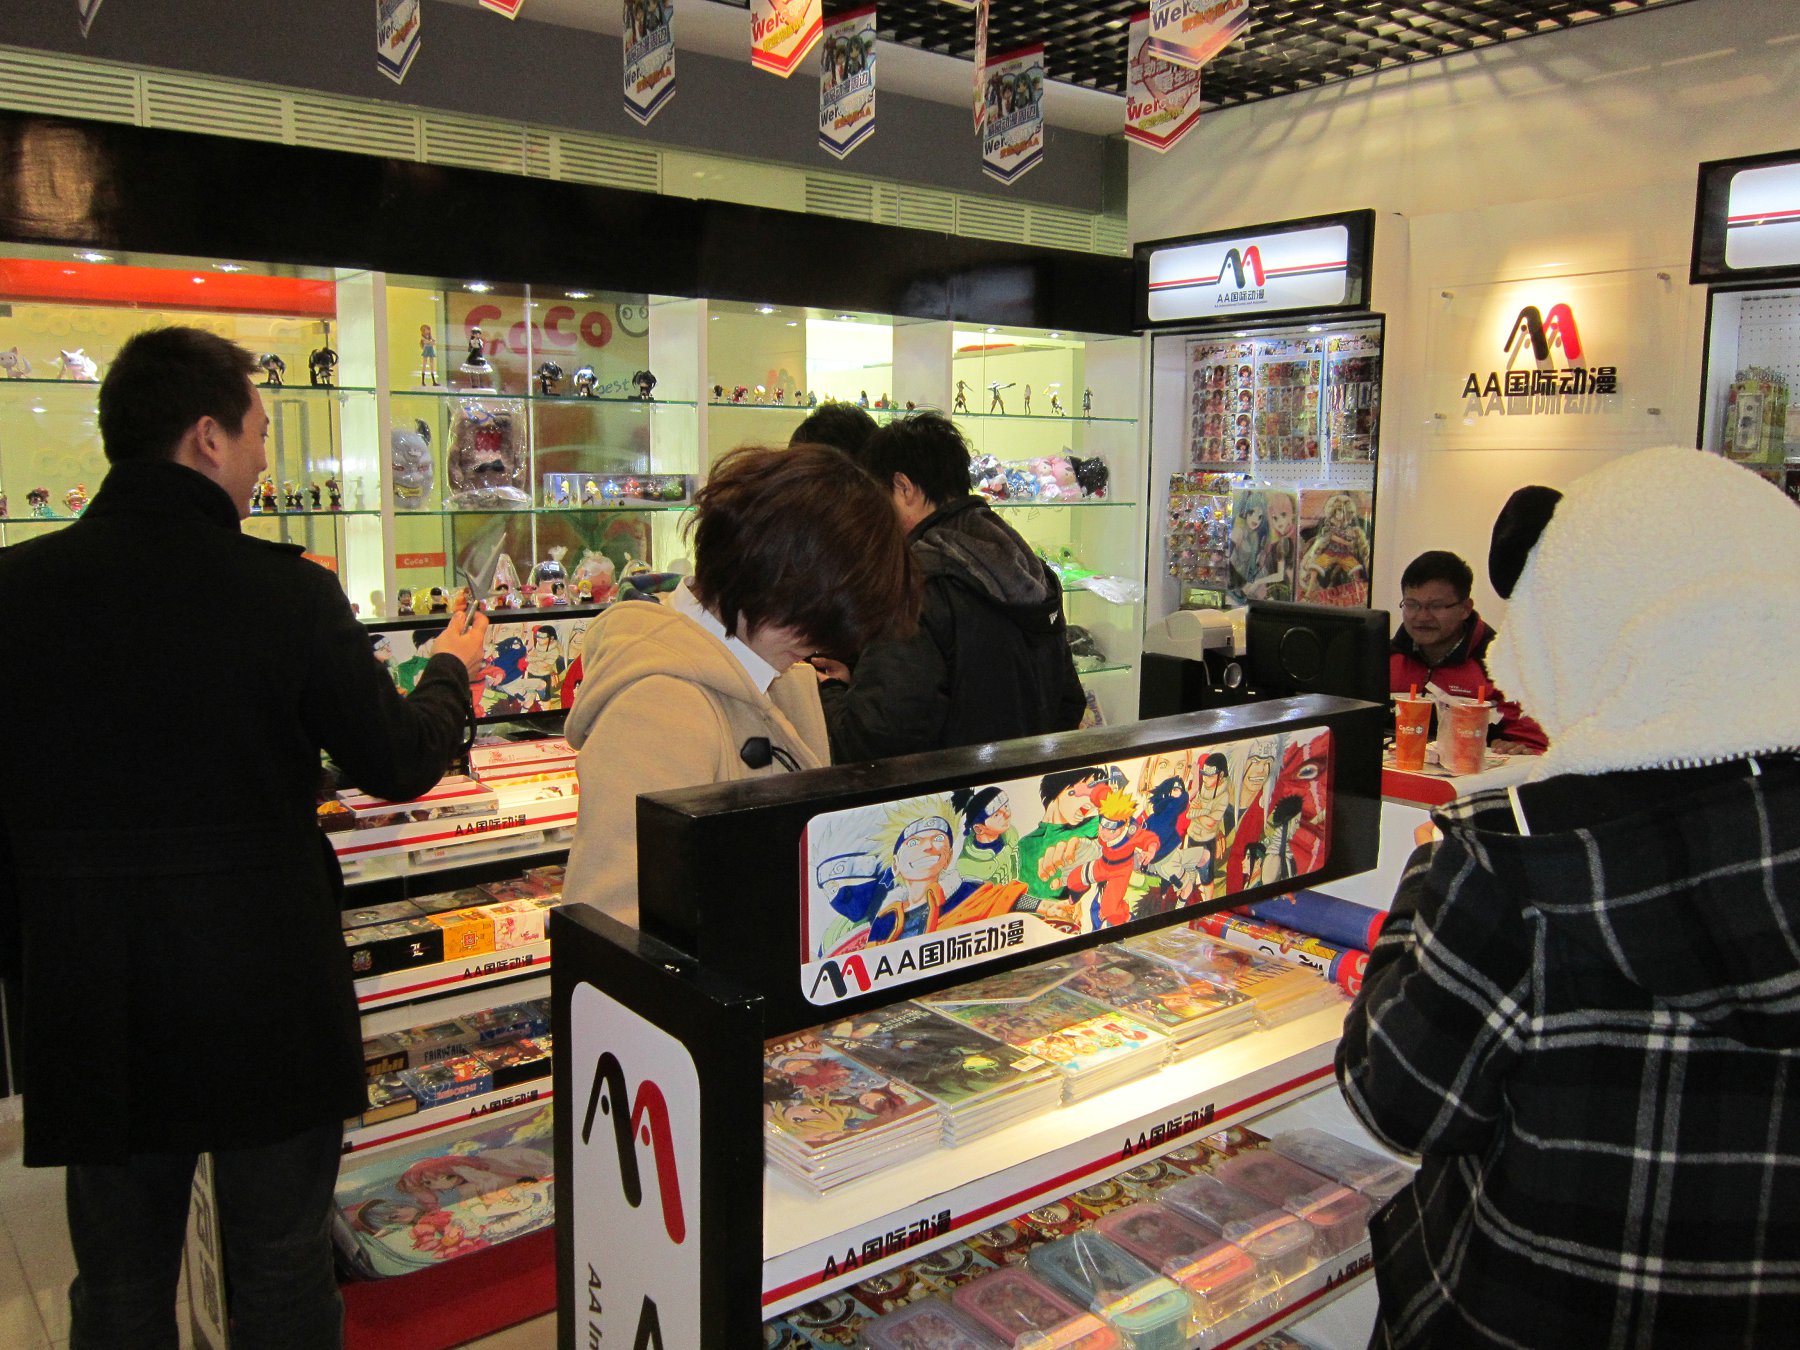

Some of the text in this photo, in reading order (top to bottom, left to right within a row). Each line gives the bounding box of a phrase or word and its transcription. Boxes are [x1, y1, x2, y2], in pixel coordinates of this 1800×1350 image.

[1217, 289, 1265, 303] AA国际动漫
[1462, 367, 1617, 398] AA国际动漫
[455, 814, 526, 837] AA国际动漫
[874, 920, 1024, 980] AA国际动漫
[464, 954, 533, 979] AA国际动漫
[1121, 1103, 1214, 1160] AA国际动漫
[822, 1209, 951, 1280] AA国际动漫
